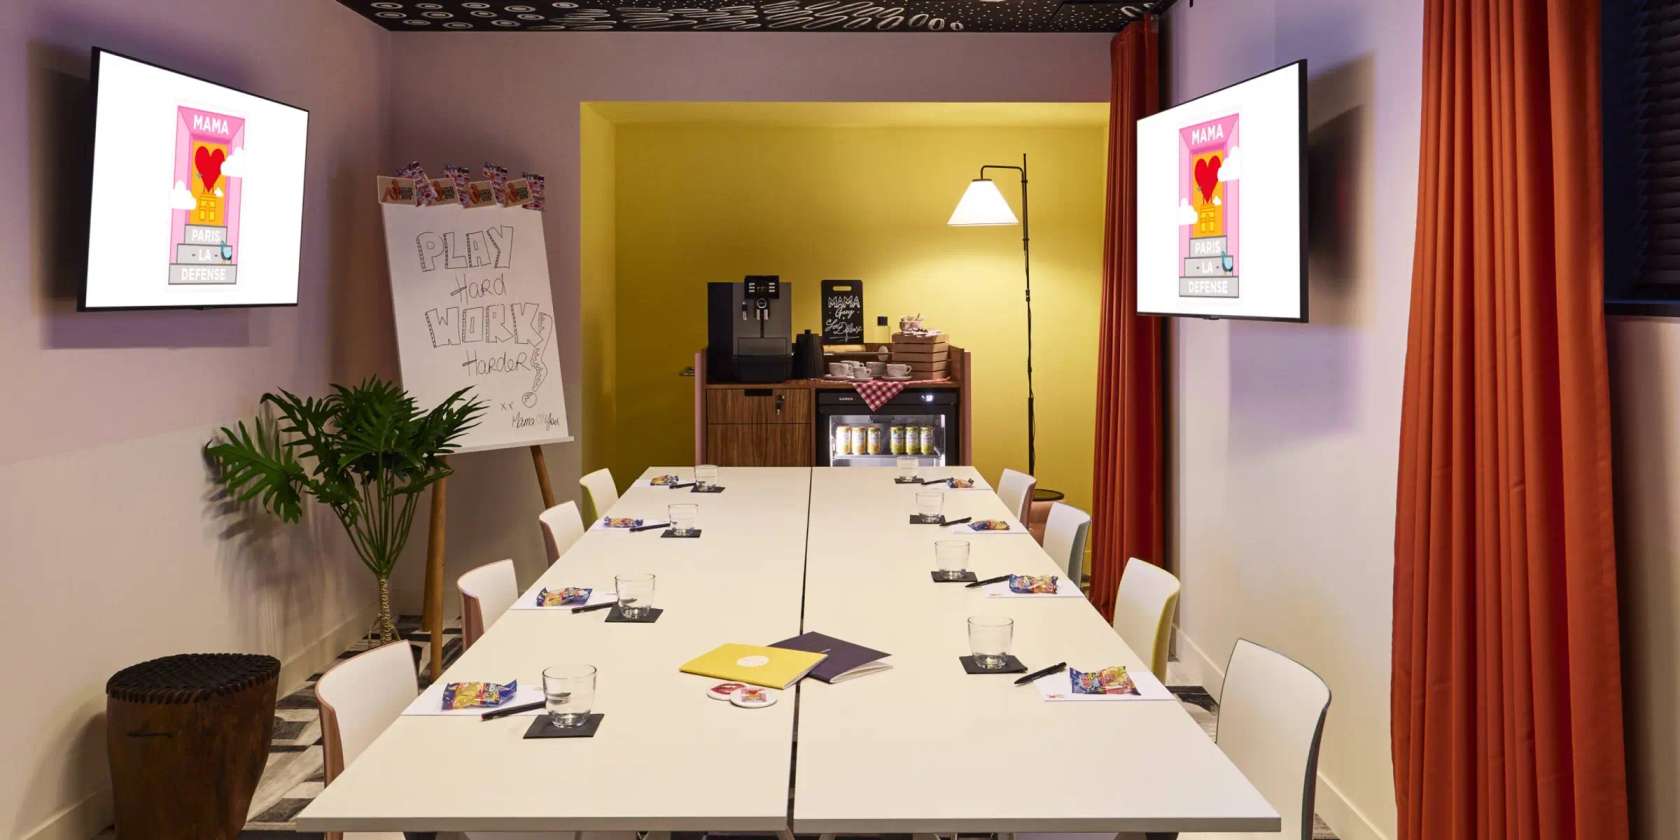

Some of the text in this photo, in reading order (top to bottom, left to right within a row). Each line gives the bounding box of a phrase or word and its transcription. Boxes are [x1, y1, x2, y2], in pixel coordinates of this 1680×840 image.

[193, 115, 229, 134] MAMA
[1191, 125, 1224, 144] MAMA
[191, 228, 221, 242] PARIS
[198, 248, 212, 261] LA
[416, 225, 514, 271] PLAY
[1194, 240, 1222, 255] PARIS
[180, 267, 227, 281] DEFENSE
[1201, 261, 1214, 274] LA
[1188, 280, 1229, 295] DEFENSE
[828, 295, 860, 308] MAMA
[425, 303, 544, 348] WORK
